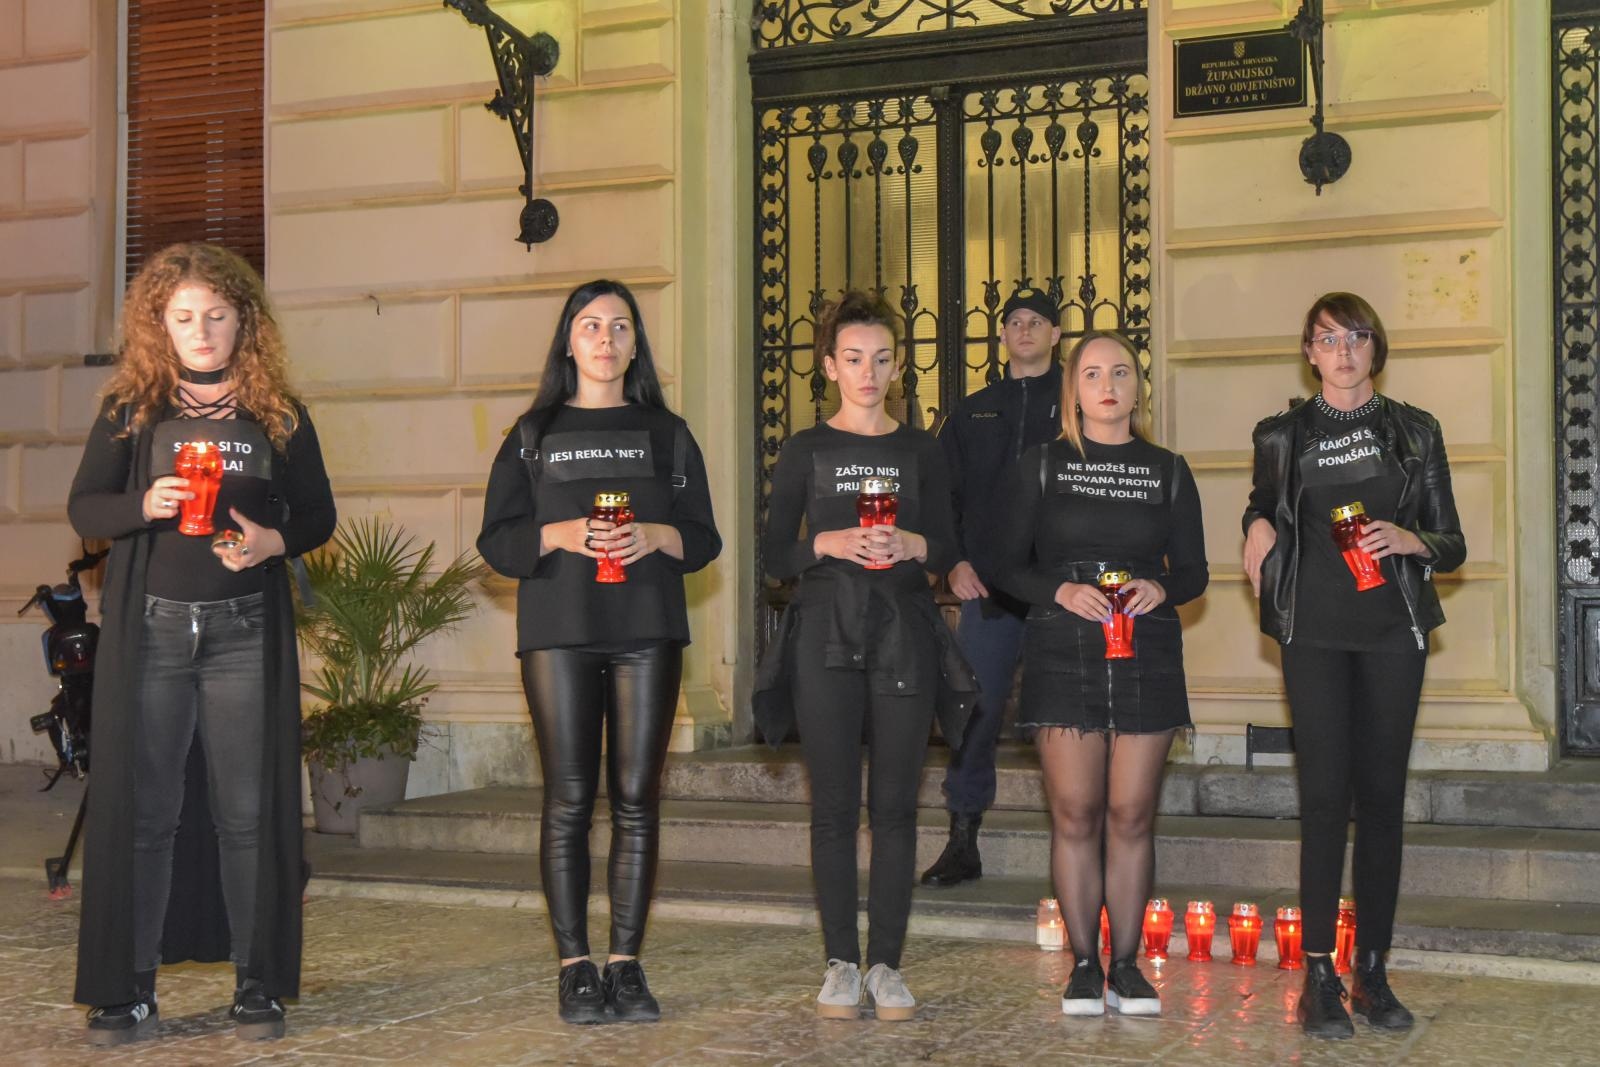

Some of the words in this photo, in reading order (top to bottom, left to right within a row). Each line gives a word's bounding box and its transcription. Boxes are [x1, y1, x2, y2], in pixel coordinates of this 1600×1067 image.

[1201, 61, 1240, 69] REPUBLIKA
[1243, 56, 1279, 65] HRVATSKA
[1207, 66, 1273, 81] ŽUPANIJSKO
[1185, 84, 1225, 96] DRŽAVNO
[1230, 76, 1295, 93] ODVJETNIŠTVO
[1212, 97, 1218, 105] U
[1225, 94, 1268, 104] ZADRU
[219, 441, 231, 452] SI
[234, 442, 252, 454] TO
[1319, 436, 1351, 451] KAKO
[1352, 430, 1362, 443] SI
[549, 451, 572, 463] JESI
[575, 449, 613, 460] REKLA
[615, 449, 645, 459] 'NE'?
[835, 464, 874, 477] ZAŠTO
[876, 467, 900, 477] NISI
[1067, 462, 1083, 471] NE
[1085, 462, 1126, 473] MOŽEŠ
[1128, 466, 1150, 475] BITI
[1057, 473, 1116, 484] SILOVANA
[1118, 478, 1161, 488] PROTIV
[1072, 484, 1107, 496] SVOJE
[1108, 489, 1147, 499] VOLJE!
